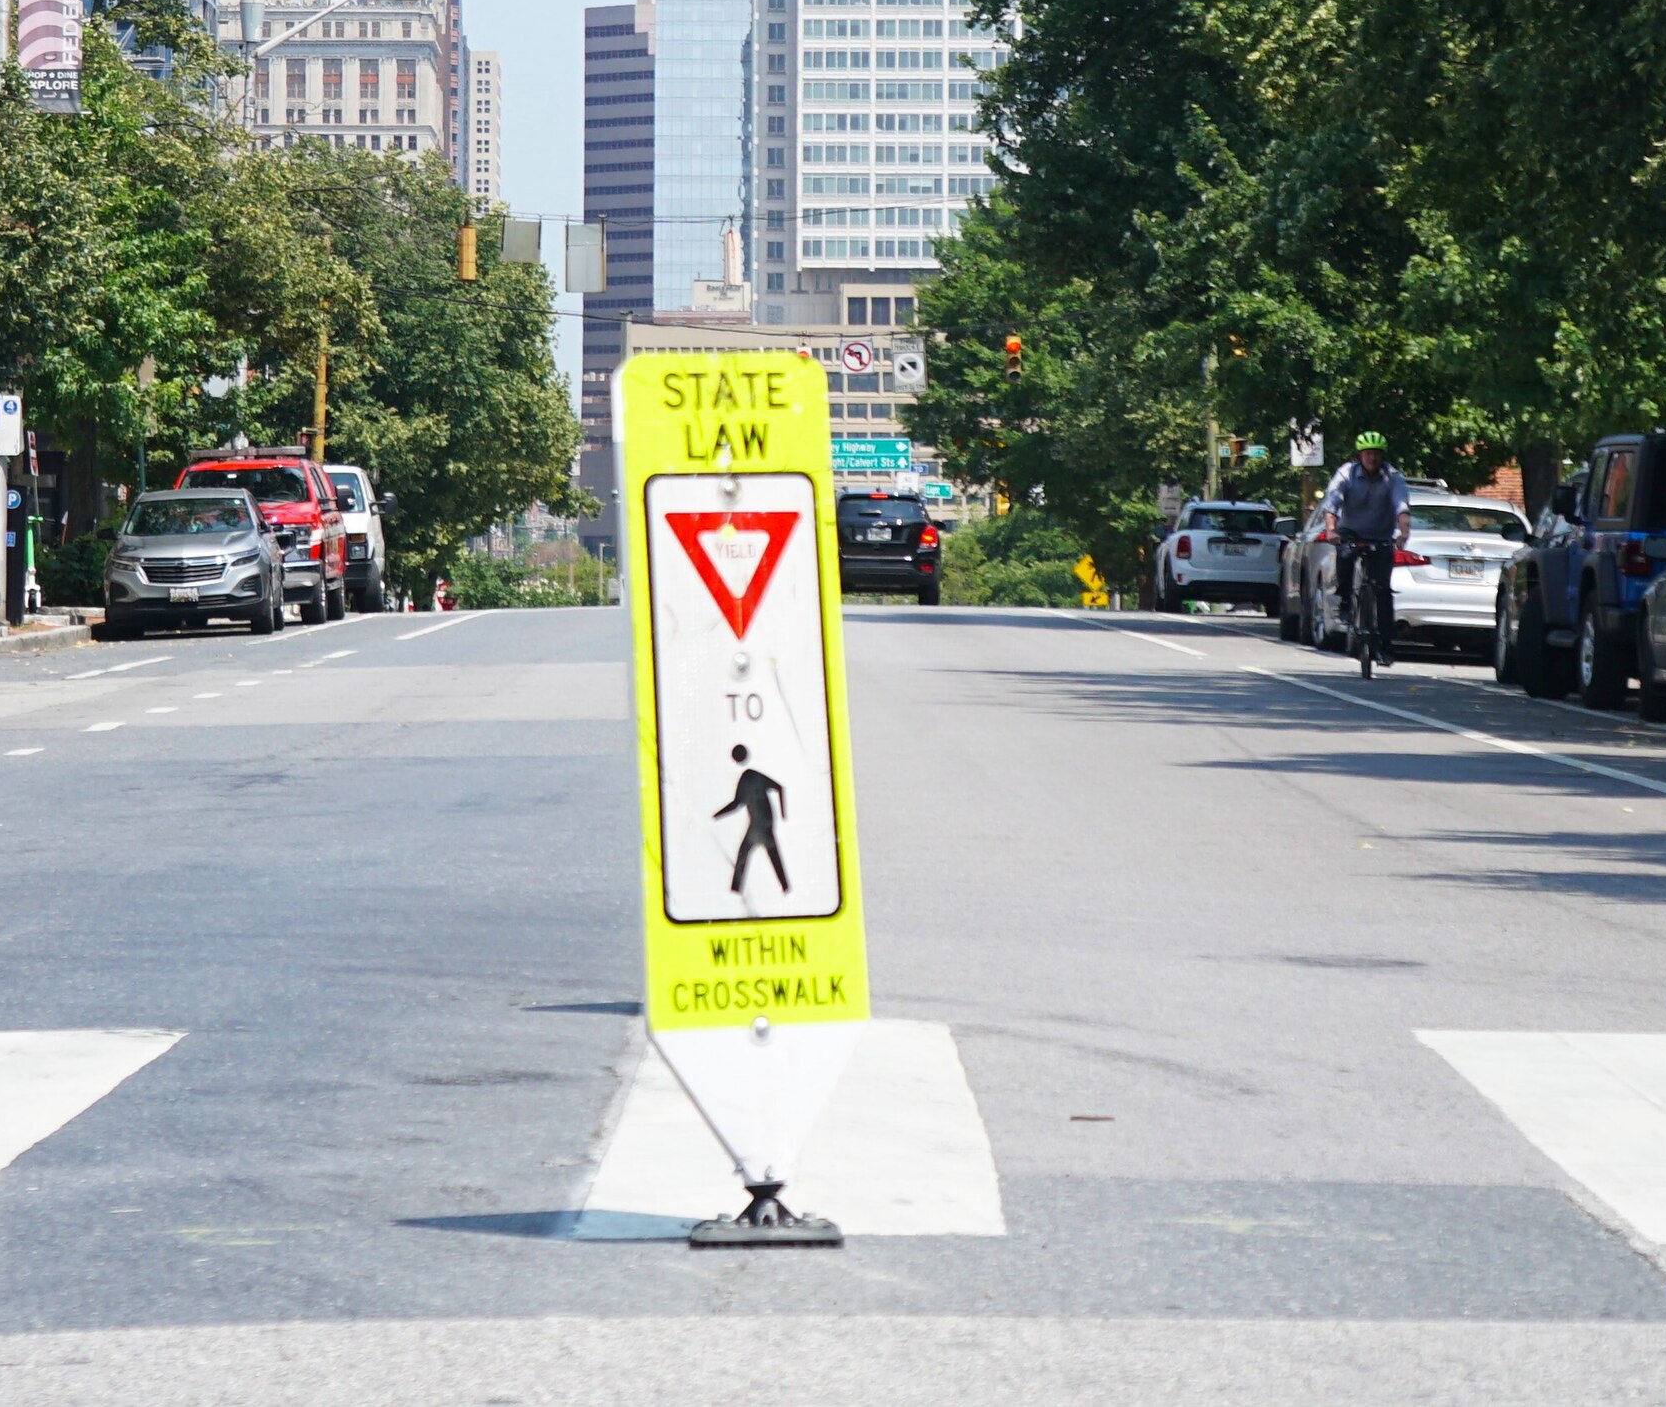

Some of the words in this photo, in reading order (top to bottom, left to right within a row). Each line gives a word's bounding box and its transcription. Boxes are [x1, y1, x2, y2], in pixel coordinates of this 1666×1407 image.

[28, 80, 79, 91] XPLORE
[57, 71, 79, 80] DINE
[664, 371, 788, 410] STATE
[686, 423, 769, 460] LAW
[843, 442, 876, 453] Highway
[832, 457, 879, 471] ght/Calvert
[715, 543, 756, 559] YIELD
[725, 693, 764, 722] TO
[709, 934, 807, 967] WITHIN
[673, 974, 848, 1014] CROSSWALK
